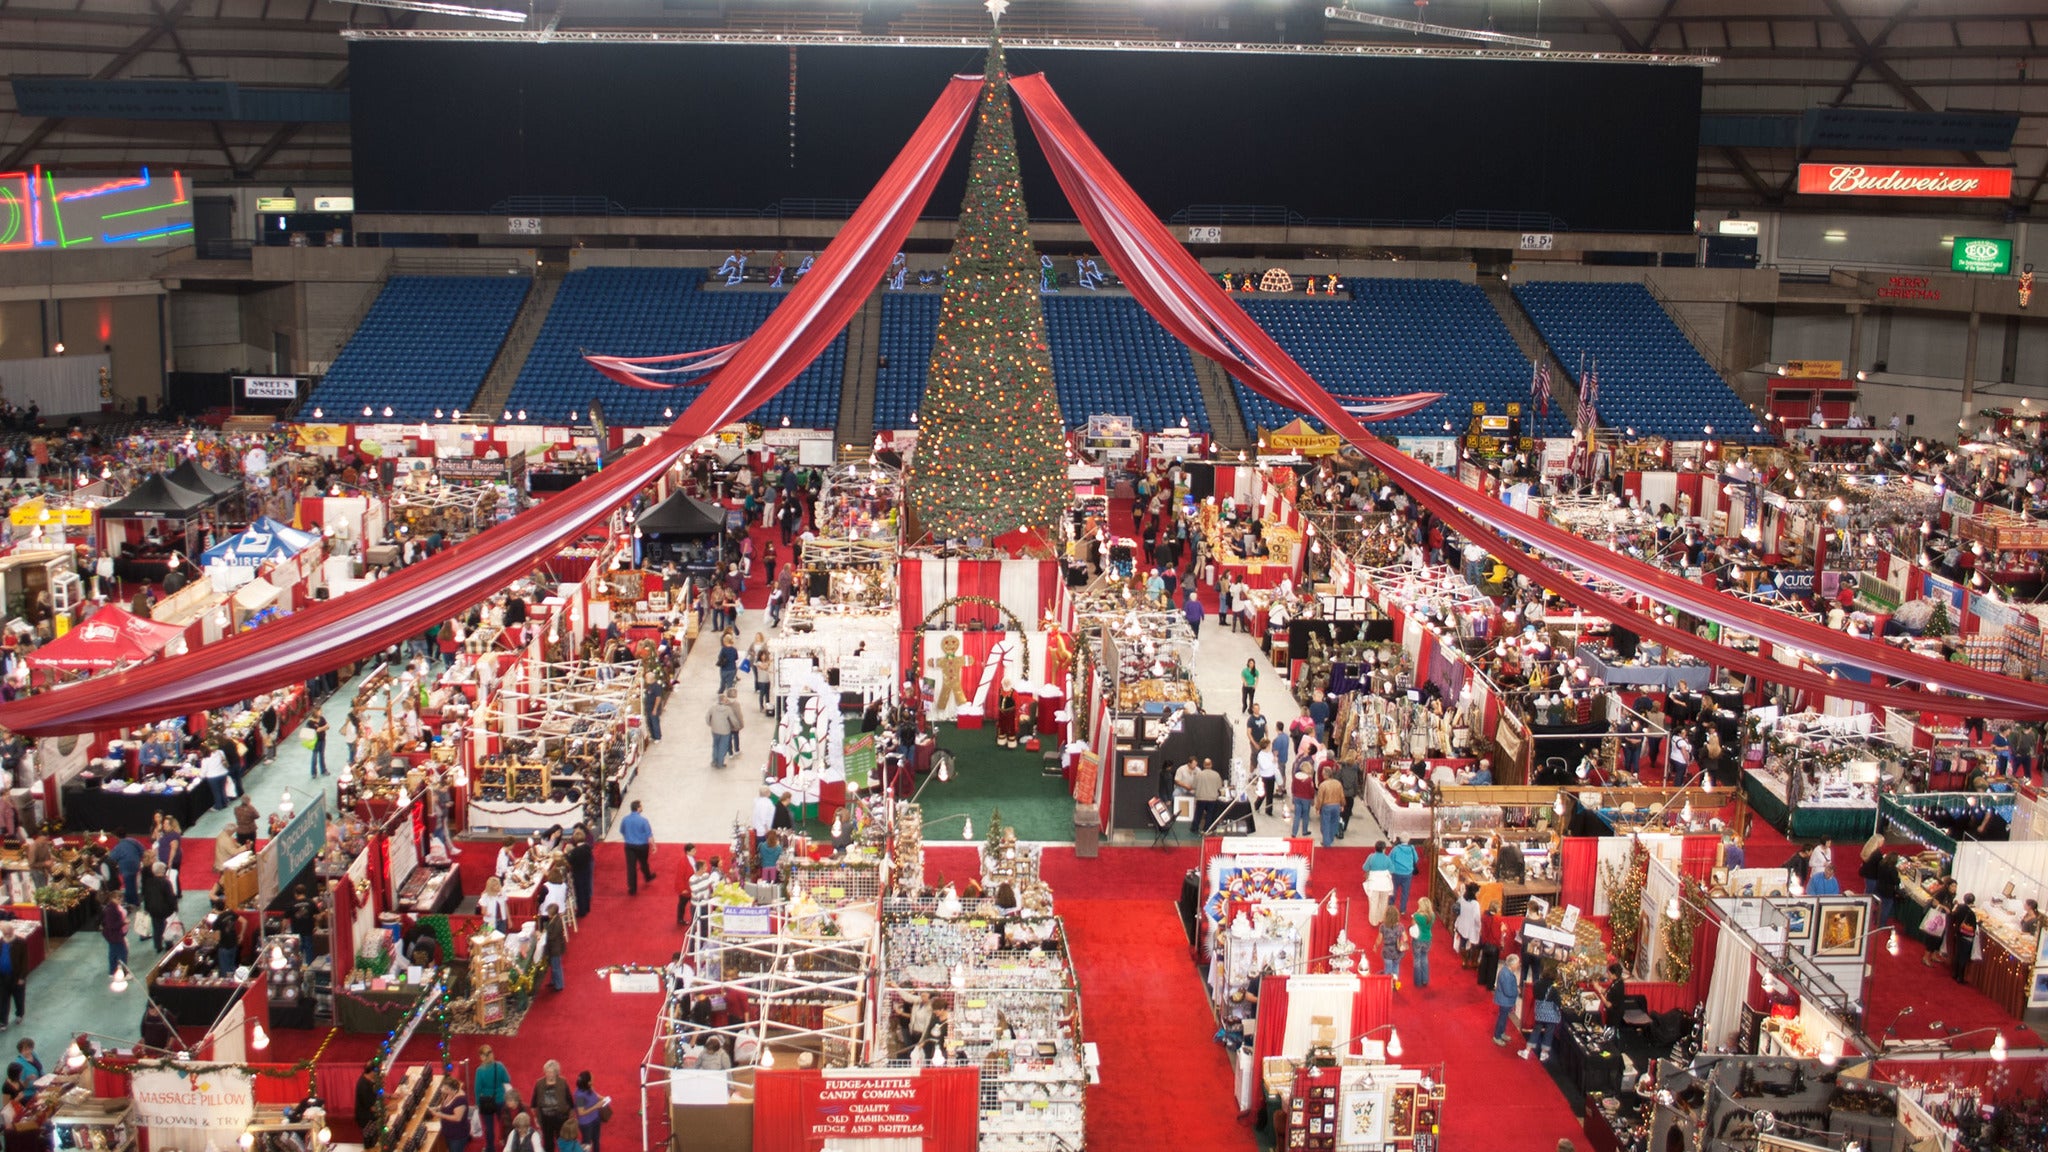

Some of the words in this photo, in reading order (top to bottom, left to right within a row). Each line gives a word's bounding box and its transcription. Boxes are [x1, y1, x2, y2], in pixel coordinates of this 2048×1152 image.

[1829, 166, 1980, 192] Budweiser
[528, 219, 536, 229] 8
[1194, 228, 1202, 237] 7
[1208, 228, 1217, 237] 6
[1527, 235, 1535, 244] 6
[1540, 235, 1547, 245] 5
[1888, 277, 1929, 288] MERRY
[1877, 287, 1941, 300] CHRISTMAS
[252, 380, 290, 388] SWEET'S
[248, 388, 294, 396] DESSERTS
[825, 1079, 911, 1090] FUDGE-A-LITTLE
[140, 1091, 197, 1105] MASSAGE
[200, 1093, 245, 1106] PILLOW
[820, 1090, 858, 1100] CANDY
[862, 1089, 916, 1099] COMPANY
[849, 1104, 890, 1113] QUALITY
[156, 1115, 197, 1125] DOWN
[202, 1118, 209, 1126] &
[217, 1116, 240, 1126] TRY
[826, 1115, 849, 1123] OLD
[854, 1114, 909, 1123] FASHIONED
[812, 1125, 846, 1133] FUDGE
[851, 1125, 873, 1133] AND
[878, 1124, 924, 1133] BRITTLES
